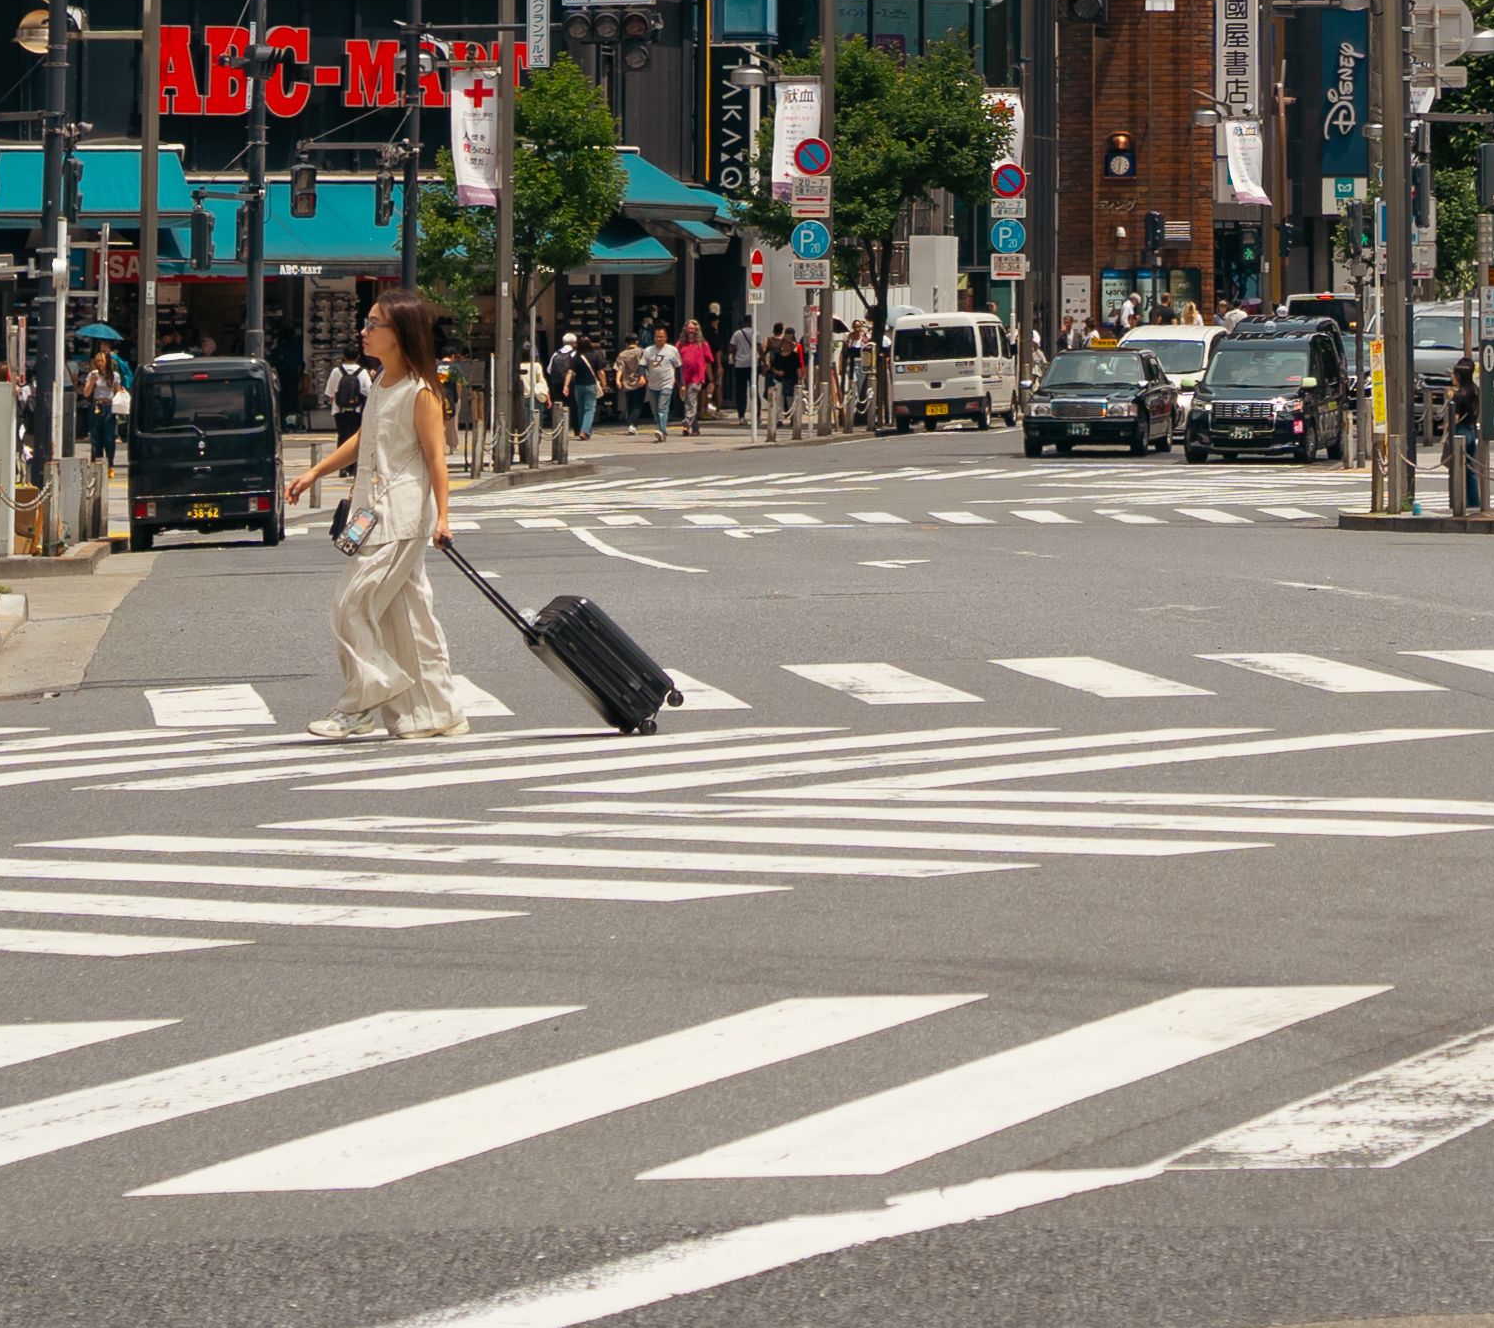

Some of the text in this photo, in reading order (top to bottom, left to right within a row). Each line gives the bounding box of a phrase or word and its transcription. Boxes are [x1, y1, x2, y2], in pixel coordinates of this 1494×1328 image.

[783, 88, 815, 104] 献血
[800, 230, 815, 254] P
[998, 226, 1012, 248] P
[1007, 238, 1018, 248] 20
[810, 242, 821, 253] 20
[279, 264, 322, 276] ABC-MART
